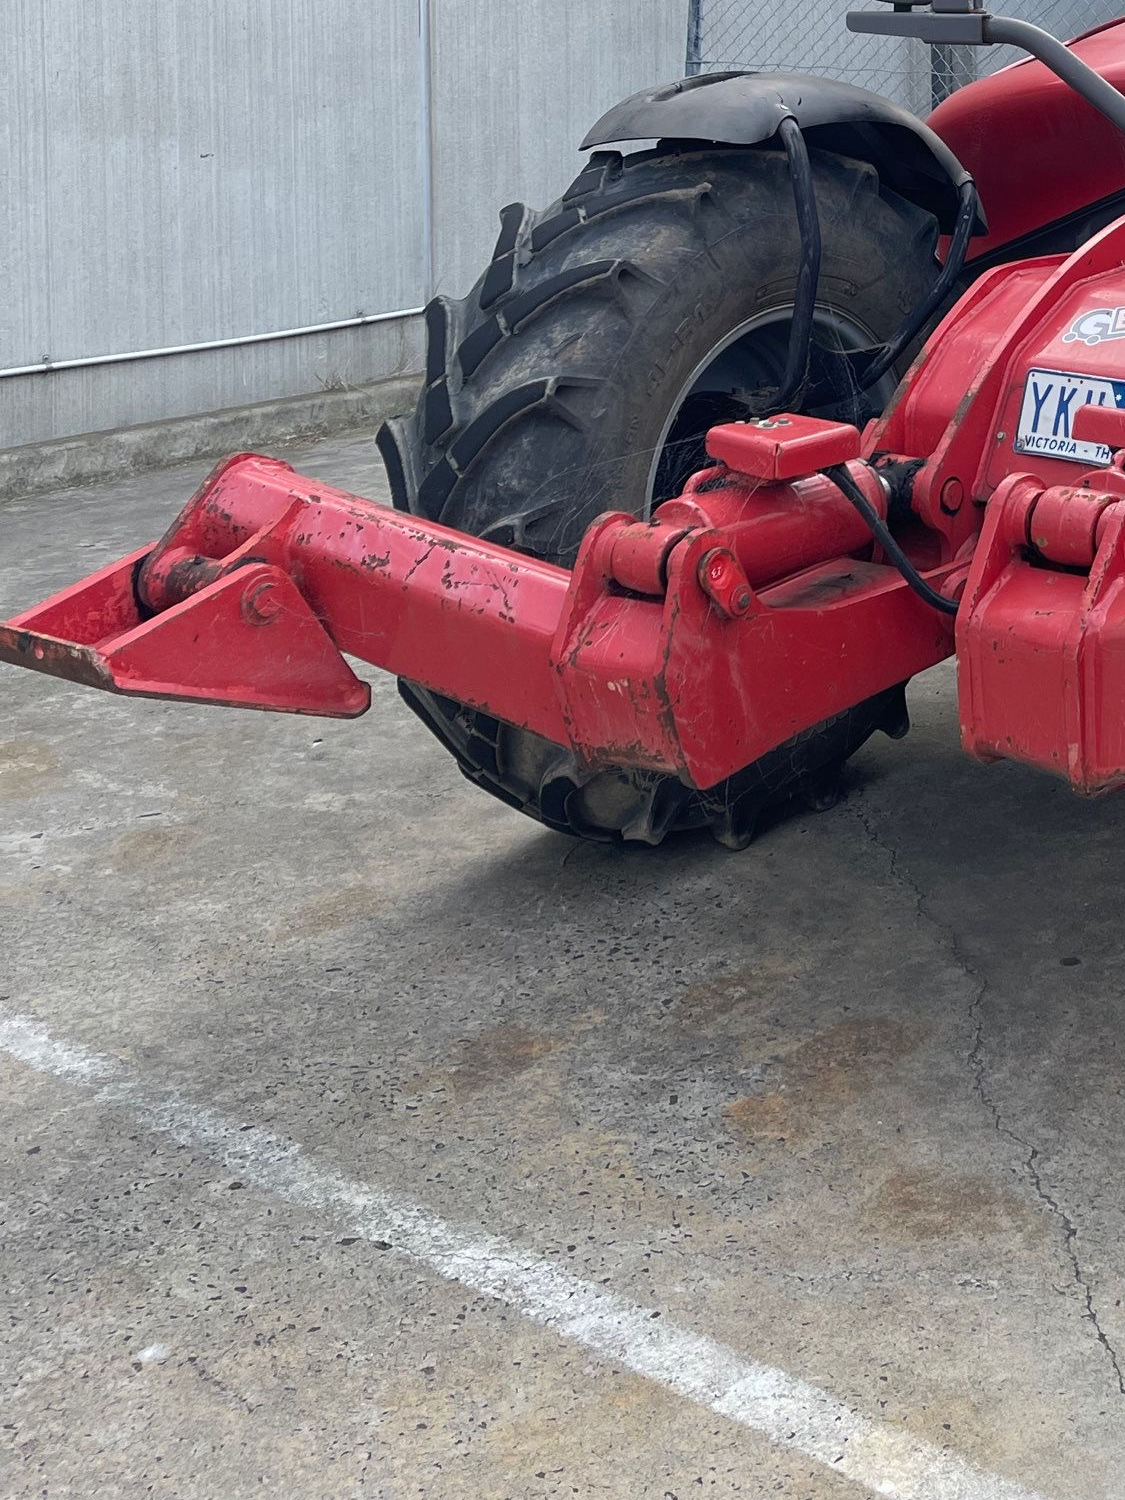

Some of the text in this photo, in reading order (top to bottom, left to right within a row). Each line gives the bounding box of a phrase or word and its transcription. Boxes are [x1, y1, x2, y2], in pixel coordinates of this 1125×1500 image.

[1031, 381, 1106, 438] YK
[1024, 435, 1077, 454] VICTORIA
[1095, 446, 1111, 460] TH
